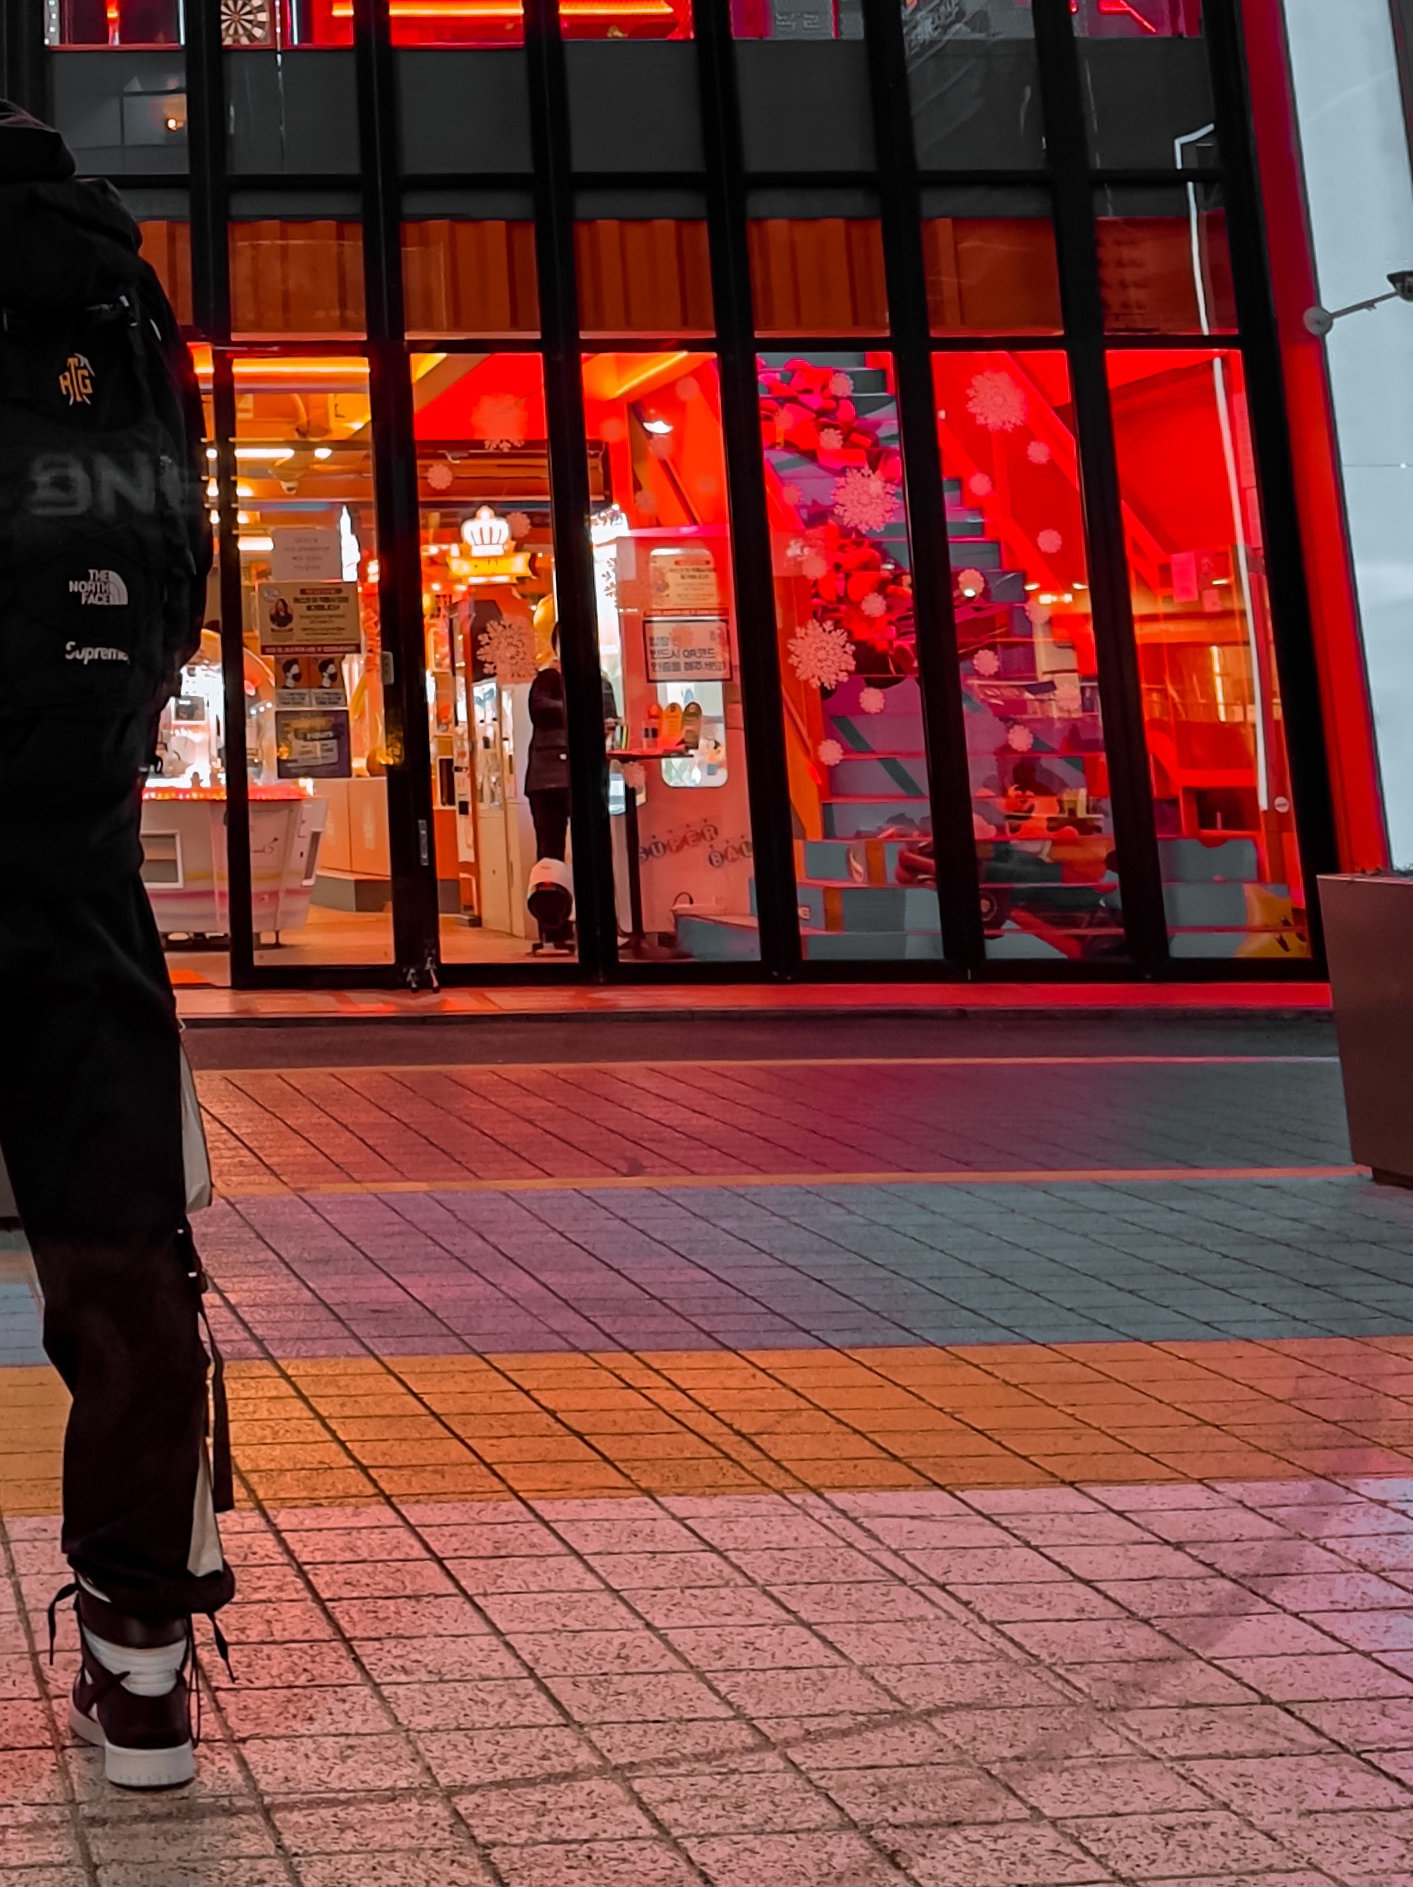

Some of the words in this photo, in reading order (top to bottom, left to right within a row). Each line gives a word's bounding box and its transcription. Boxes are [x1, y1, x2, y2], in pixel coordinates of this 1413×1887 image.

[88, 568, 110, 581] THE
[68, 580, 110, 593] NORTH
[81, 592, 110, 605] FACE
